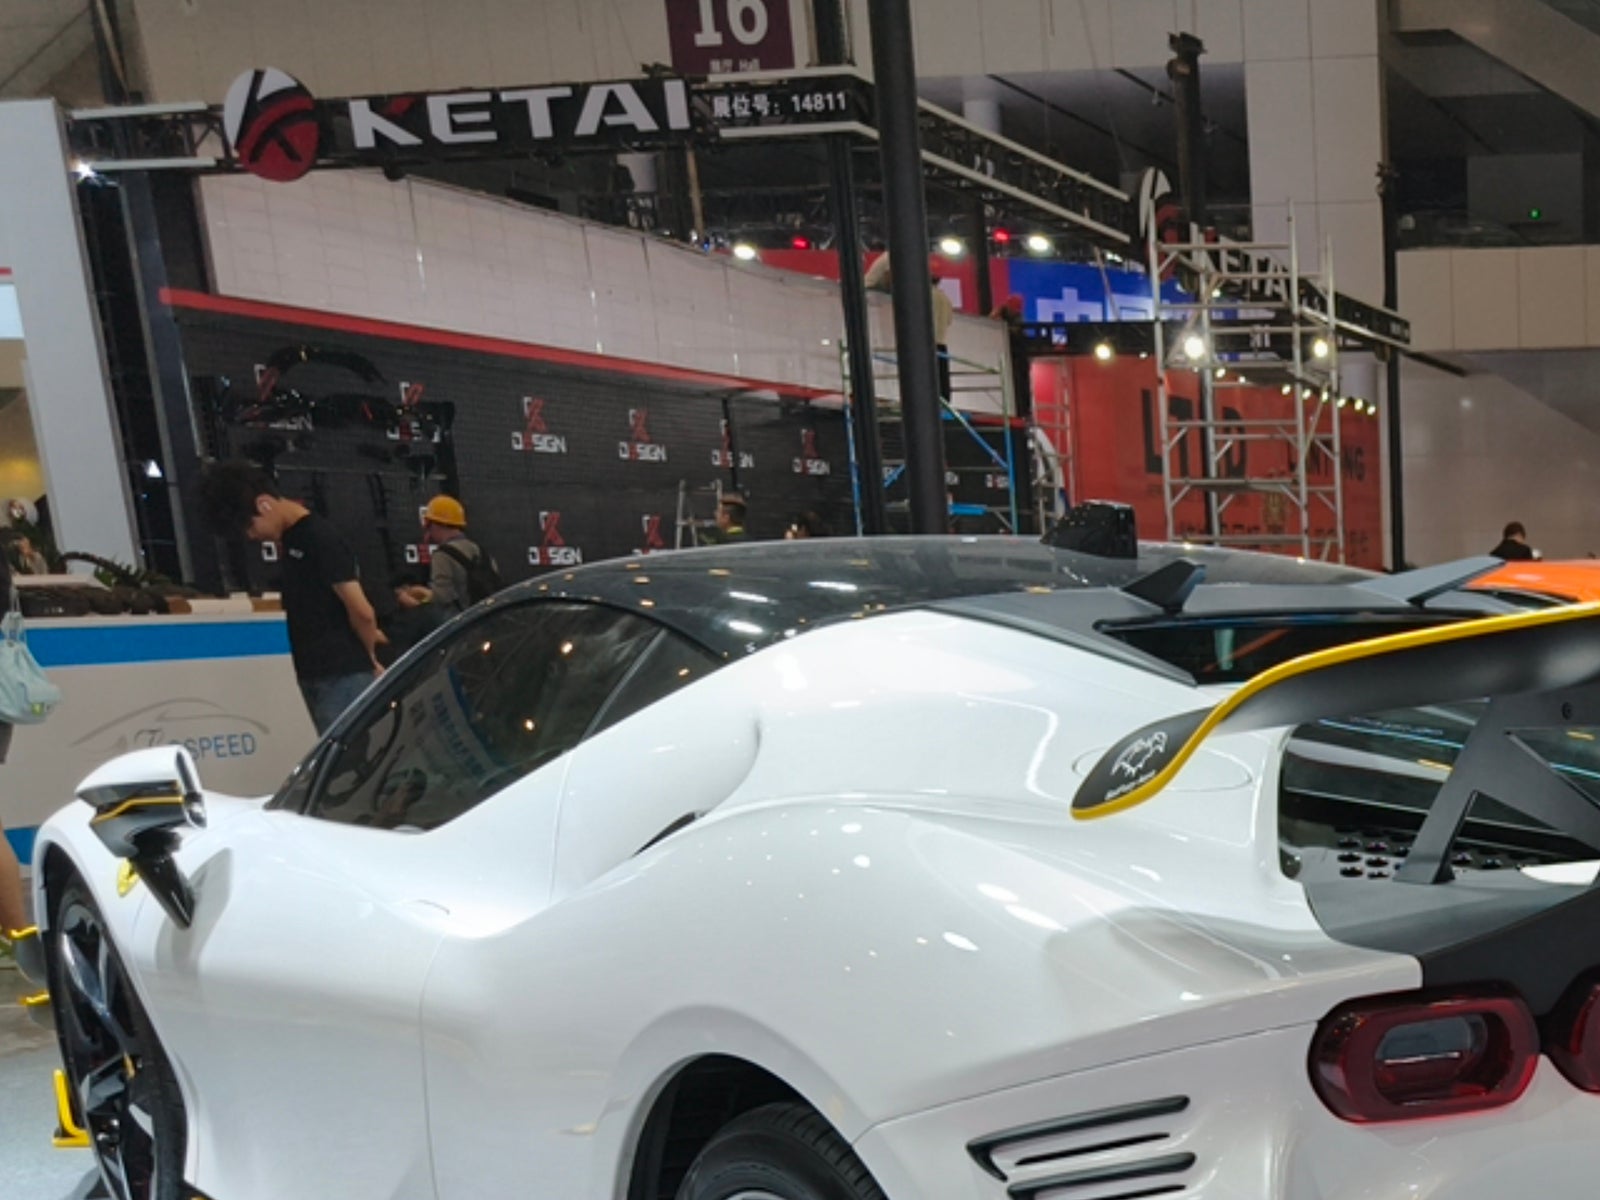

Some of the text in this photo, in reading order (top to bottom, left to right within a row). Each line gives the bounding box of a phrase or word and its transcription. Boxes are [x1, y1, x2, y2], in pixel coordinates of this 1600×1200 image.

[693, 0, 769, 47] 16
[348, 79, 692, 149] KETAI
[791, 91, 847, 113] 14811
